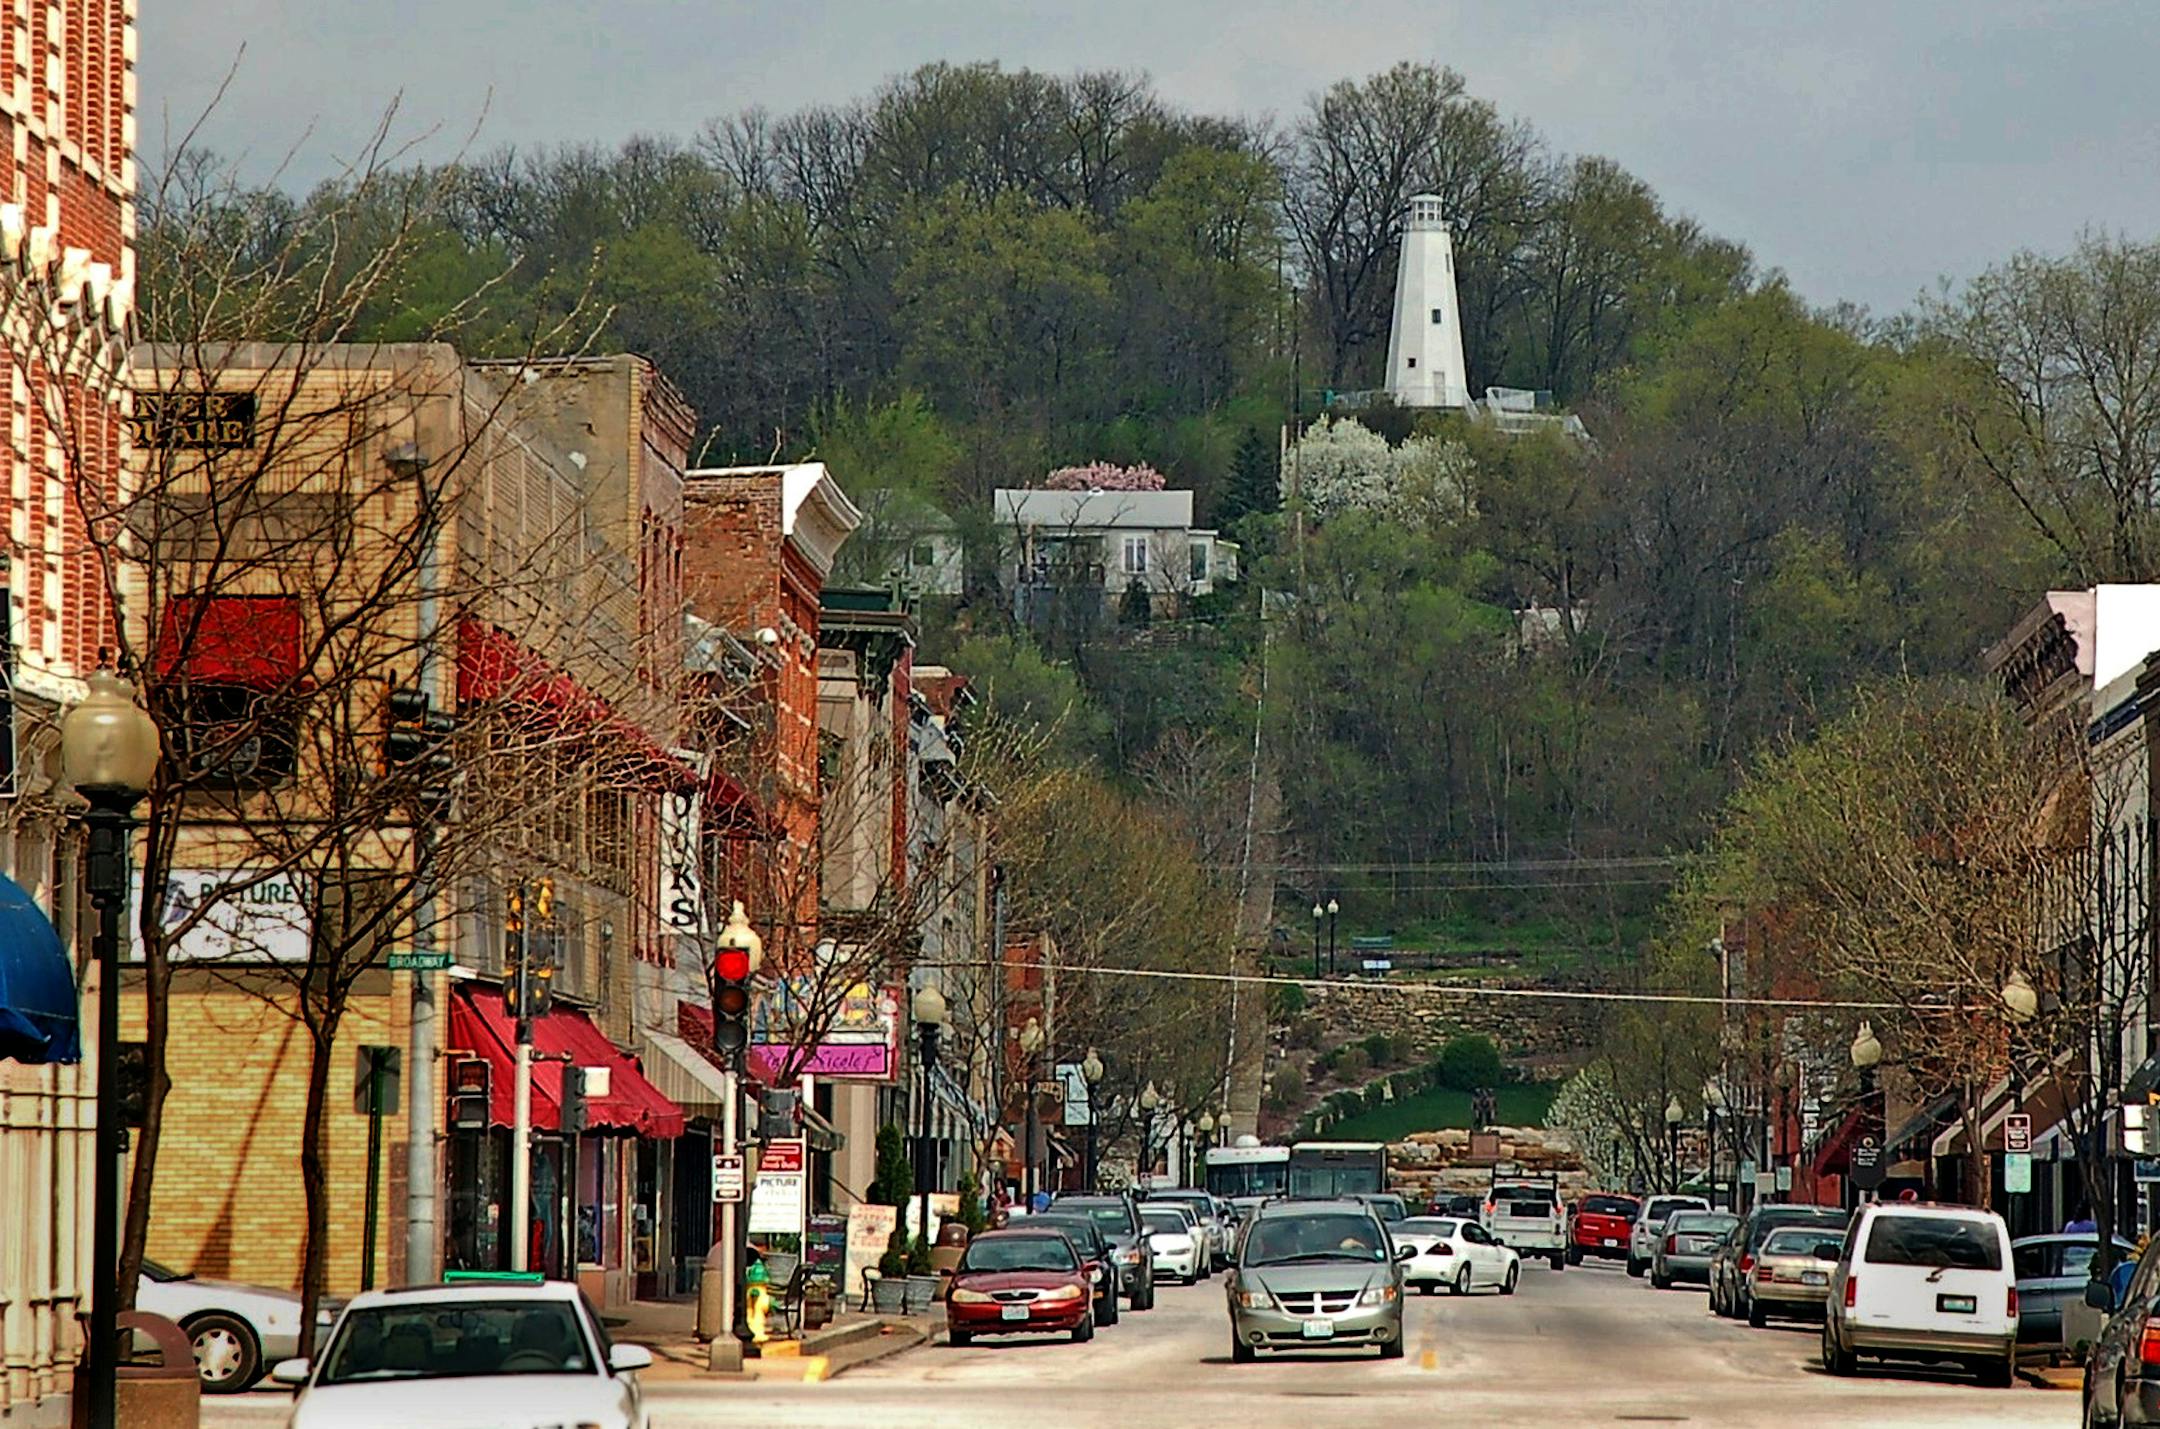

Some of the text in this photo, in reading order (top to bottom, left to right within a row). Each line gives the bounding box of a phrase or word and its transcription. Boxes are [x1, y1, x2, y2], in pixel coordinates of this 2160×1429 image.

[200, 881, 295, 904] PTURE
[388, 955, 446, 968] BROADWAY
[760, 1178, 797, 1187] PICTURE
